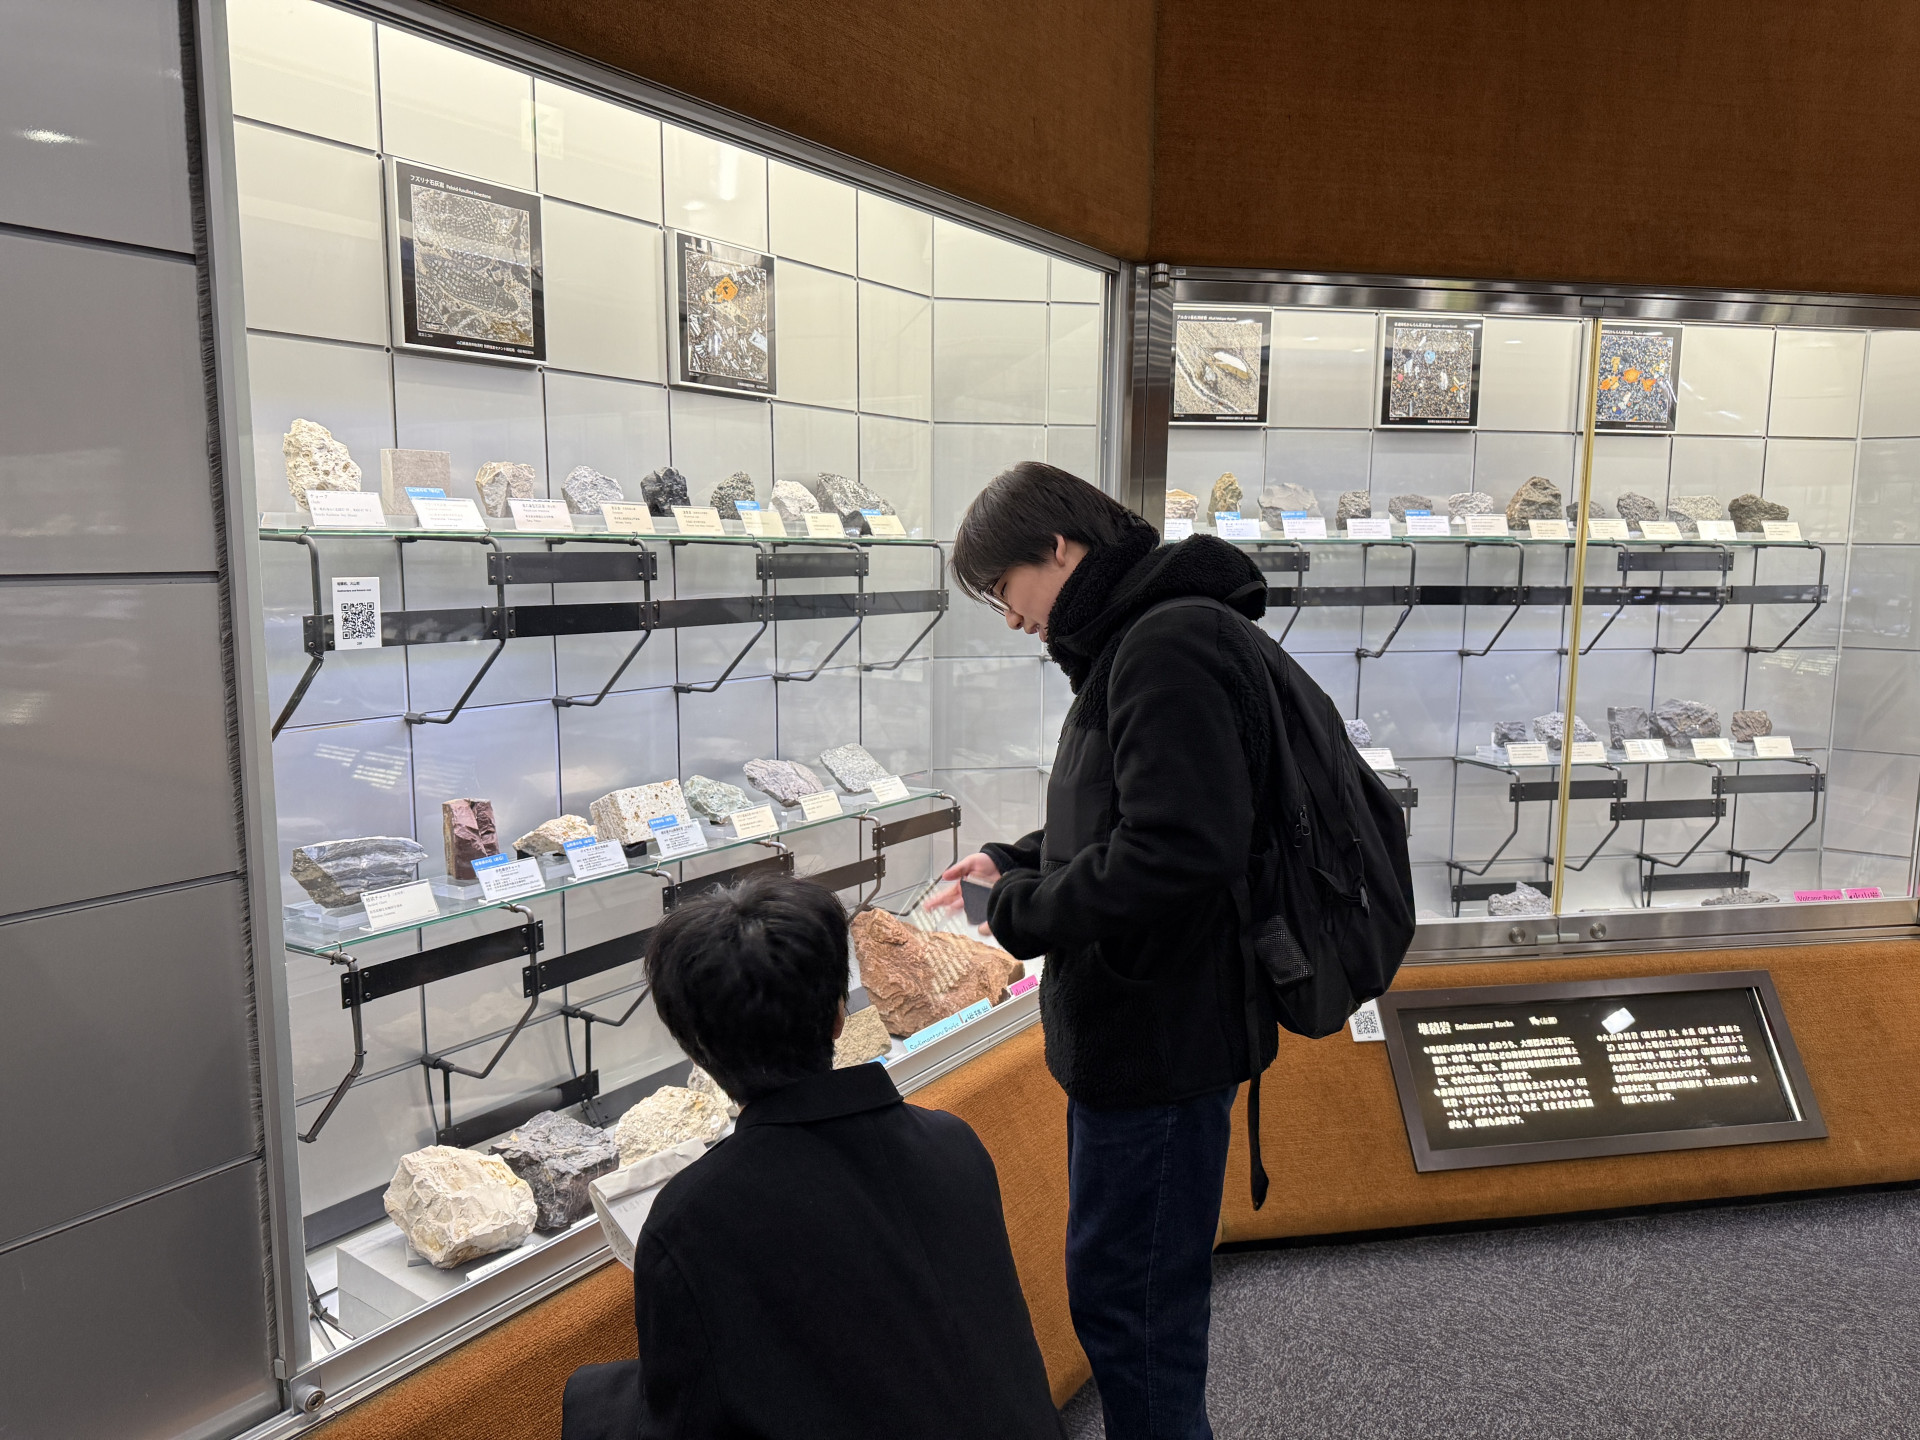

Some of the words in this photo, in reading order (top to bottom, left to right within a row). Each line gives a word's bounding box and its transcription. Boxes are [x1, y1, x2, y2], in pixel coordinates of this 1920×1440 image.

[1418, 1021, 1452, 1035] 堆積岩
[1454, 1022, 1494, 1031] Sedimentary
[1494, 1019, 1515, 1028] Rocks
